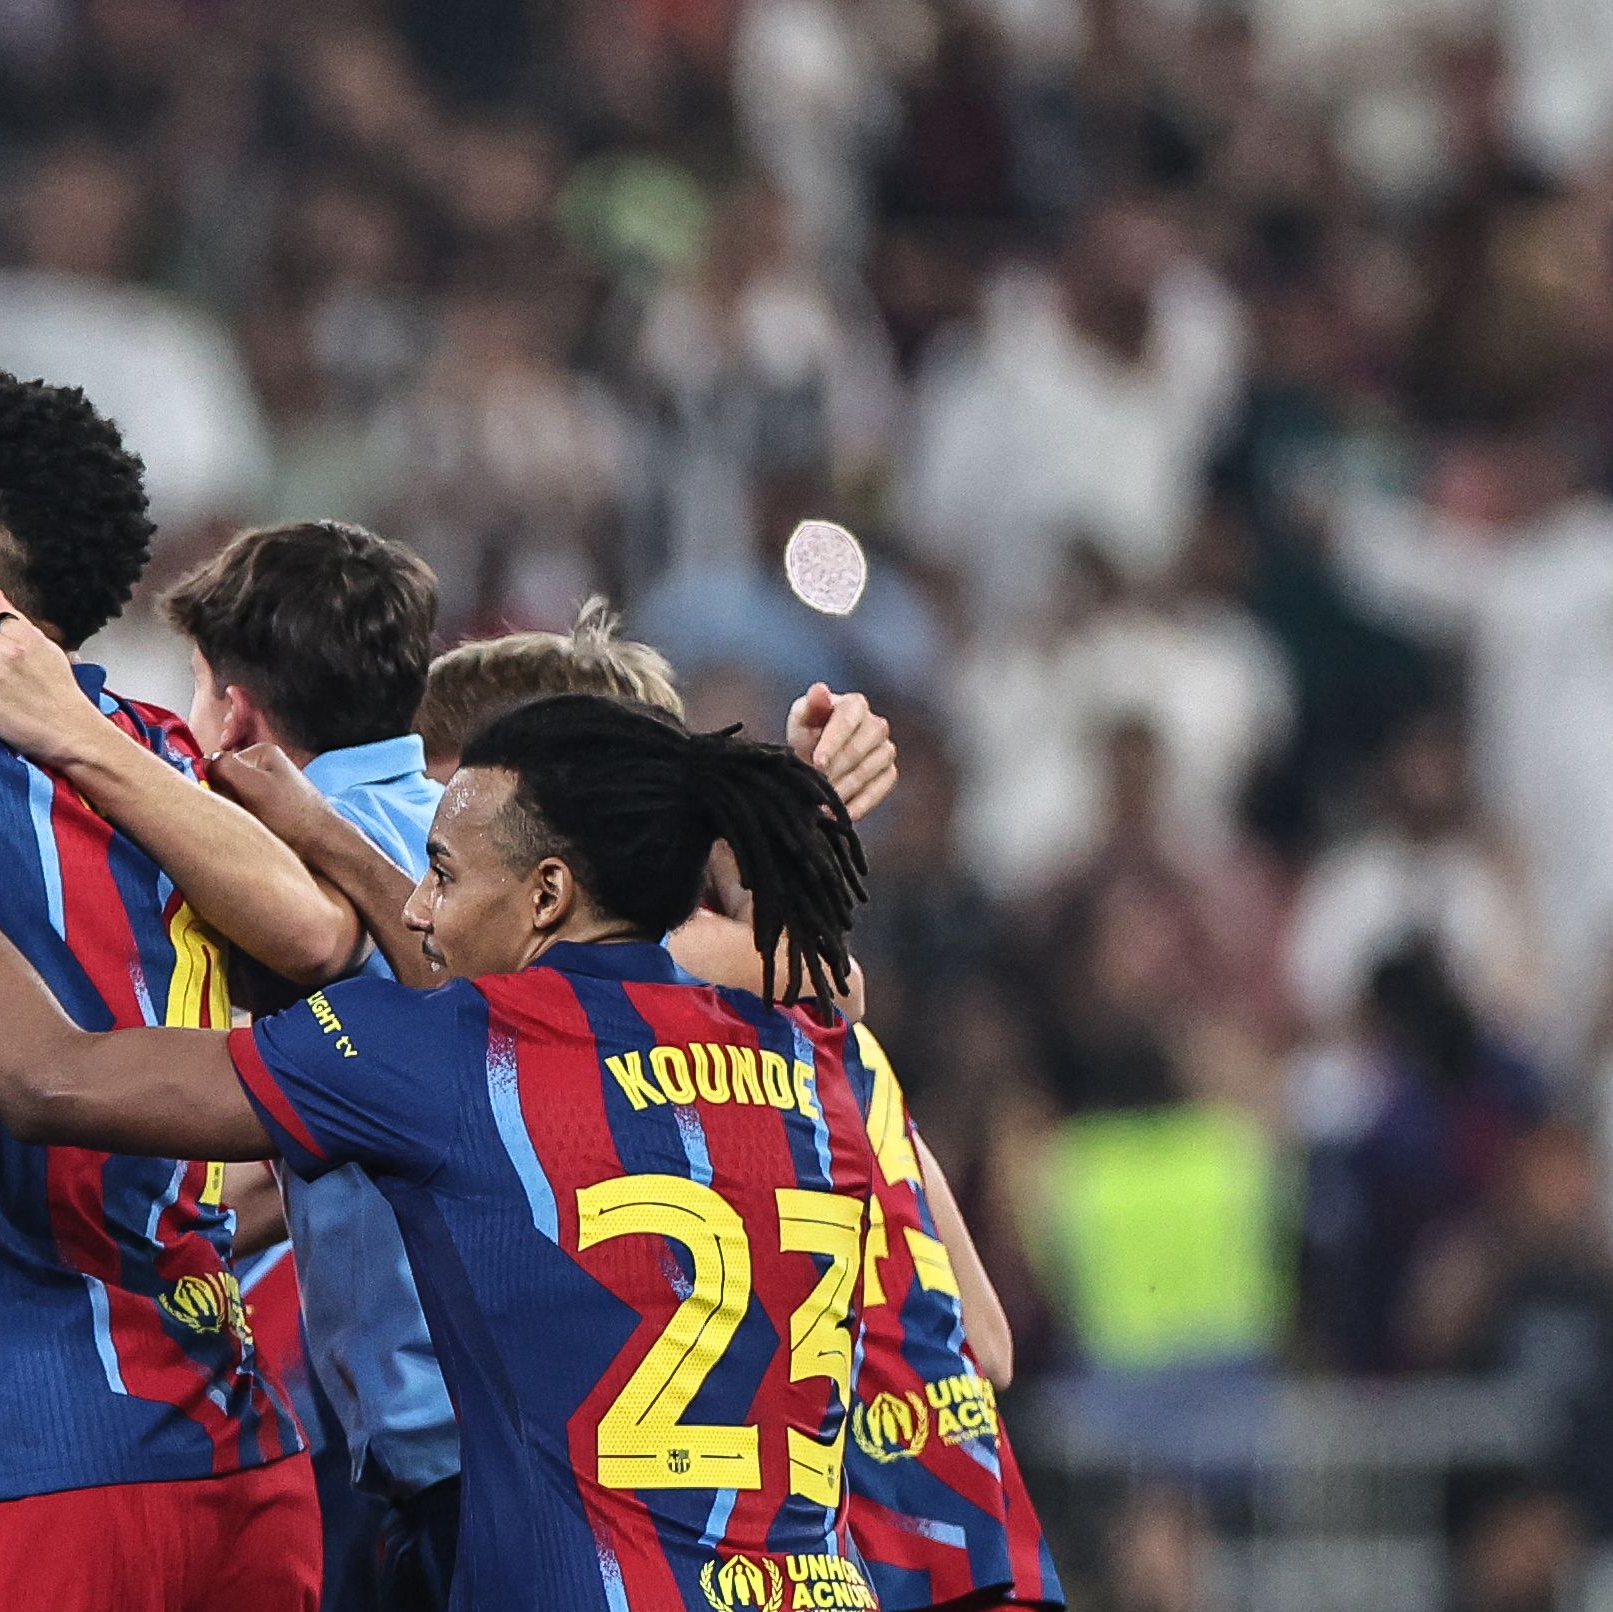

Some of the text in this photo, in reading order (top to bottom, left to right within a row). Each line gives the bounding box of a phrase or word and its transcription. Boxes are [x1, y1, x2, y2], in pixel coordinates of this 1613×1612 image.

[307, 990, 358, 1057] LIGHT tv
[605, 1042, 822, 1120] KOUNDE
[575, 1174, 865, 1508] 23
[792, 1582, 877, 1610] ACNUR
